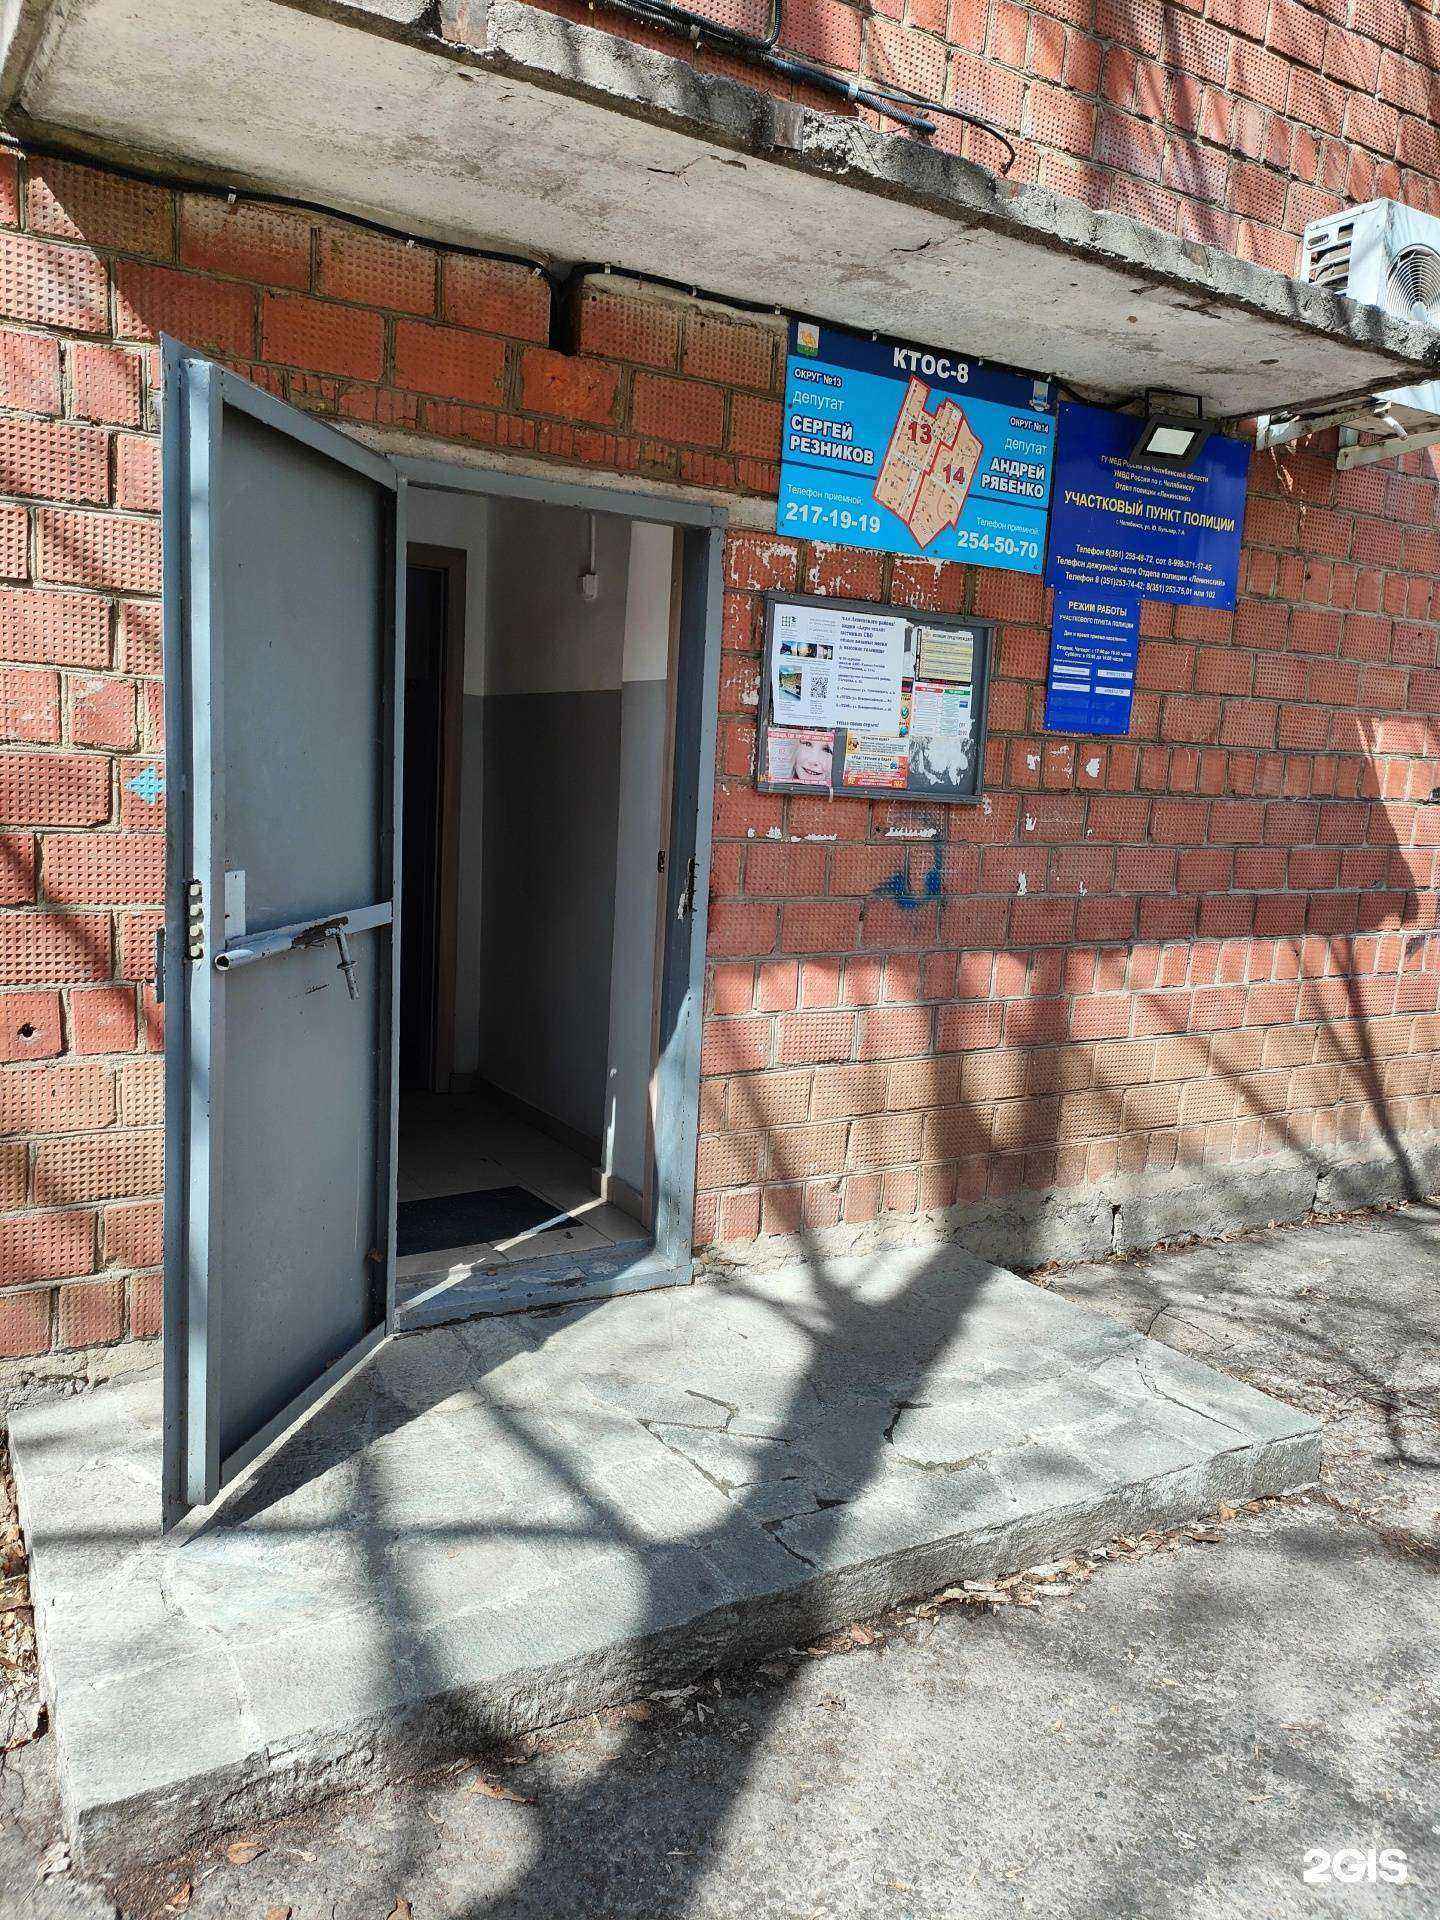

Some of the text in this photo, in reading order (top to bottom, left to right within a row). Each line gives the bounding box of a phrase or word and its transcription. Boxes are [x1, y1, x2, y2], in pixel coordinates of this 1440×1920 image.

[894, 347, 968, 384] КТОС-8
[795, 369, 842, 387] ОКРУГ №13
[792, 391, 844, 410] депутат
[791, 415, 853, 441] СЕРГЕЙ
[908, 421, 932, 445] 13
[1010, 417, 1049, 433] ОКРУГ №14
[790, 435, 874, 464] РЕЗНИКОВ
[1005, 438, 1047, 455] депутат
[943, 464, 965, 484] 14
[991, 458, 1045, 480] АНДРЕЙ
[1151, 465, 1186, 479] Челябинской
[1187, 471, 1209, 483] области
[981, 474, 1044, 498] РЯБЕНКО
[1130, 474, 1151, 484] России
[787, 484, 823, 498] Телефон
[1115, 482, 1132, 493] Отдел
[1133, 486, 1155, 497] полиции
[785, 502, 881, 533] 217-19-19
[1064, 490, 1236, 532] УЧАСТКОВЫЙ ПУНКТ ПОЛИЦИИ
[976, 517, 1006, 530] Телефон
[957, 530, 1039, 559] 254-50-70
[1076, 544, 1105, 557] Телефон
[1105, 548, 1124, 560] 8(351)
[1056, 556, 1226, 587] Телефон дежурной части Отдела полиции «Ленинский»
[1065, 571, 1094, 585] Телефон
[1193, 589, 1205, 597] или
[1206, 591, 1216, 599] 102
[1068, 601, 1127, 616] РЕЖИМ РАБОТЫ
[1059, 614, 1134, 629] УЧАСТКОВОГО ПУНКТА ПОЛИЦИИ
